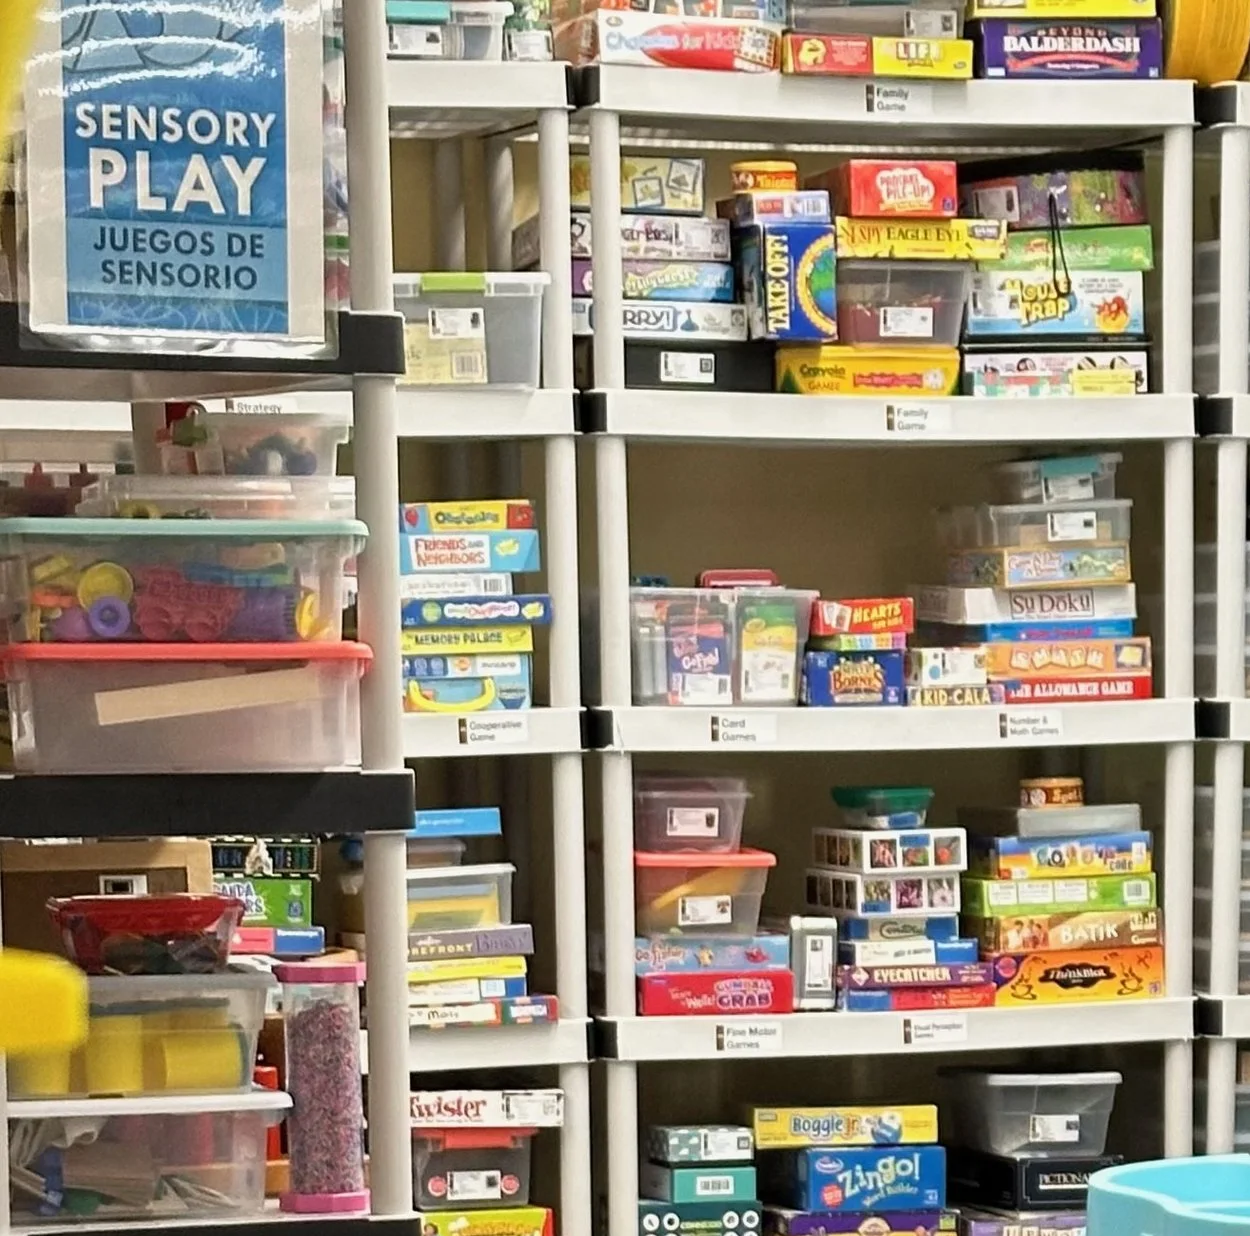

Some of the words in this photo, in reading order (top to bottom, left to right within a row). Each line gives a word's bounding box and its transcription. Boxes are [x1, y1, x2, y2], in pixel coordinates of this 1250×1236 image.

[1037, 25, 1107, 36] BEYOND
[1003, 35, 1141, 52] BALDERDASH
[877, 87, 909, 100] Family
[877, 101, 906, 111] Game
[75, 102, 277, 148] SENSORY
[88, 147, 267, 216] PLAY
[93, 225, 216, 258] JUEGOS
[227, 232, 265, 258] DE
[860, 228, 882, 244] SPY
[886, 227, 933, 241] EAGLE
[101, 259, 258, 290] SENSORIO
[623, 309, 672, 326] RRY!
[800, 363, 846, 378] Crayola
[808, 380, 840, 391] GAMES
[237, 402, 283, 414] Strategy
[897, 407, 928, 420] Family
[897, 421, 926, 431] Game
[414, 538, 467, 551] FRIENDS
[416, 551, 486, 566] NEIGHBORS
[853, 602, 902, 624] HEARTS
[415, 633, 460, 646] MEMORY
[1034, 681, 1099, 698] ALLOWANCE
[1101, 680, 1134, 695] GAME
[469, 721, 522, 731] Cooperative
[720, 718, 746, 727] Card
[470, 733, 496, 742] Game
[721, 730, 757, 742] Games
[1031, 727, 1059, 736] Games
[1060, 922, 1119, 944] BATIK
[873, 966, 951, 983] EYECATCHER
[716, 992, 772, 1008] GRAB
[726, 1027, 747, 1037] Fine
[748, 1027, 777, 1036] Motor
[726, 1040, 760, 1050] Games
[792, 1116, 843, 1137] Boggle
[837, 1152, 921, 1198] Zingo!
